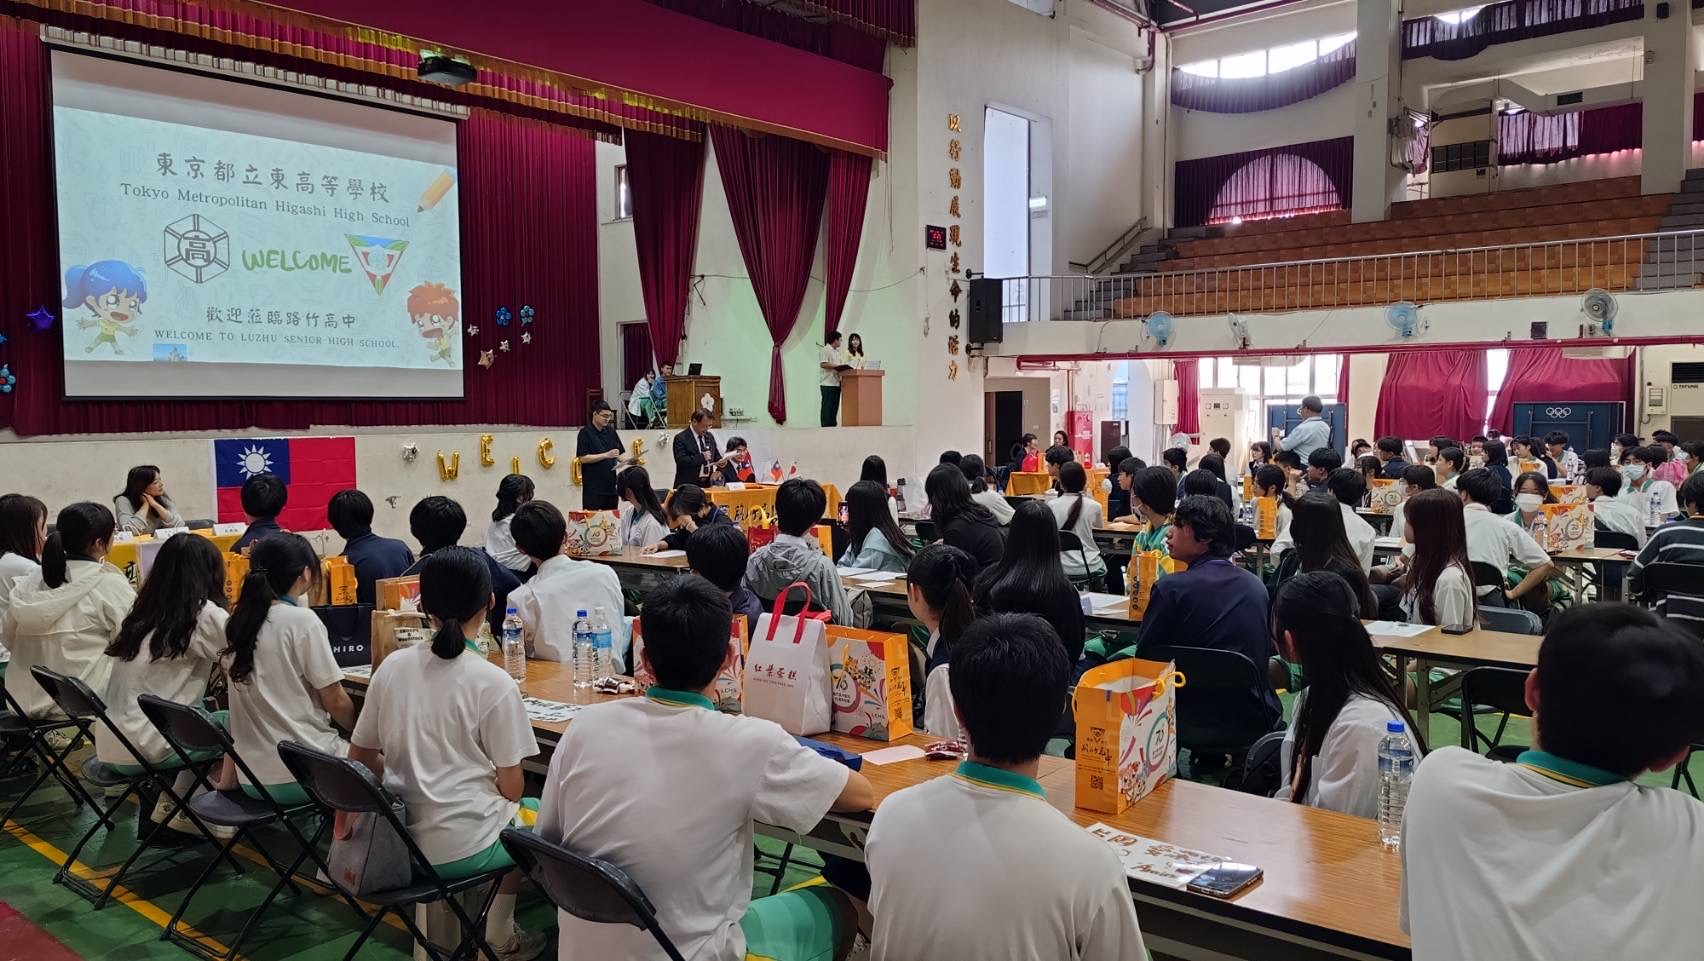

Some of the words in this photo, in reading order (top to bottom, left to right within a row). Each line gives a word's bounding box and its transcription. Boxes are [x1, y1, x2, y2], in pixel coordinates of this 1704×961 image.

[156, 152, 390, 203] 東京都立東高等學校
[120, 182, 169, 200] Tokyo
[177, 188, 267, 210] Metropolitan
[275, 200, 326, 217] Higashi
[333, 207, 364, 223] High
[371, 212, 410, 227] School
[183, 234, 211, 263] 高
[242, 250, 352, 273] WELCOME
[206, 306, 356, 328] 歡迎蒞臨路竹高中
[155, 330, 212, 341] WELCOME
[219, 332, 234, 340] TO
[241, 333, 277, 343] LUZHU
[284, 335, 322, 345] SENIOR
[328, 336, 354, 346] HIGH
[333, 644, 364, 653] HIRO
